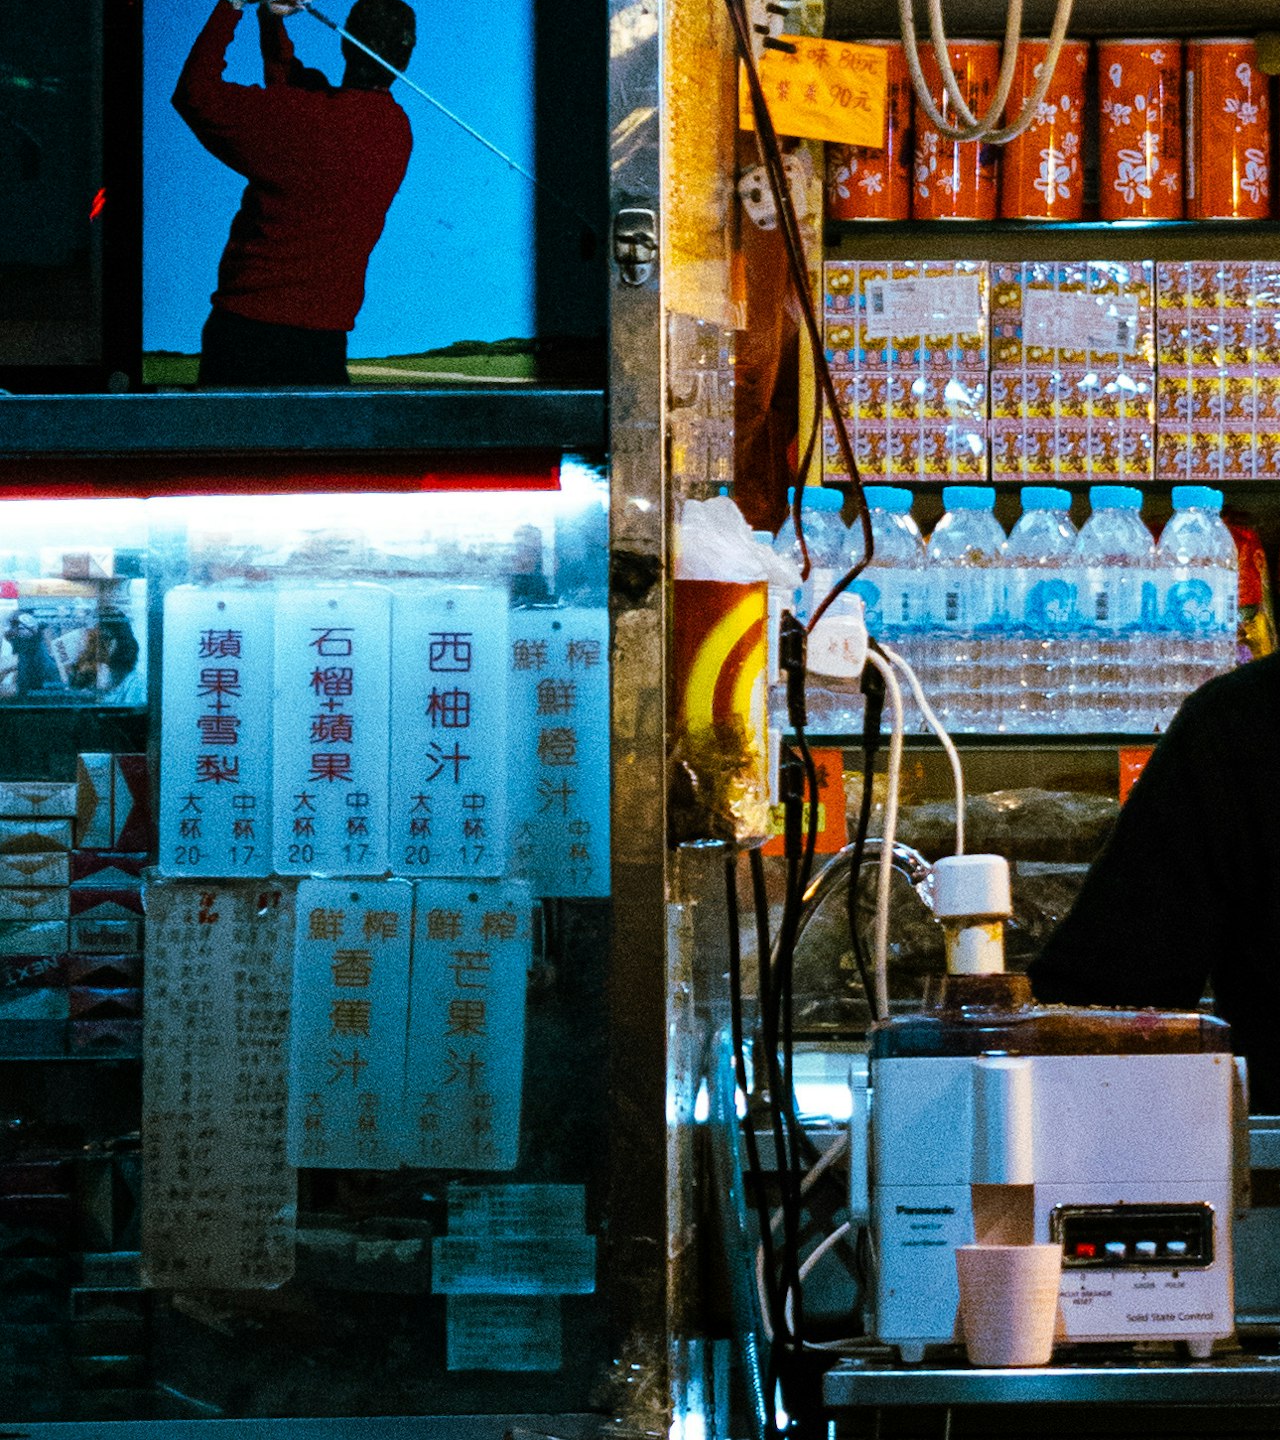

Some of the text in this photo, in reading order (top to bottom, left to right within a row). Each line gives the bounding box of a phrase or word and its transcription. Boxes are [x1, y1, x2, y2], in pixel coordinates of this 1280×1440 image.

[425, 632, 473, 785] 西柚汁
[1126, 1312, 1214, 1322] Solid State Control
